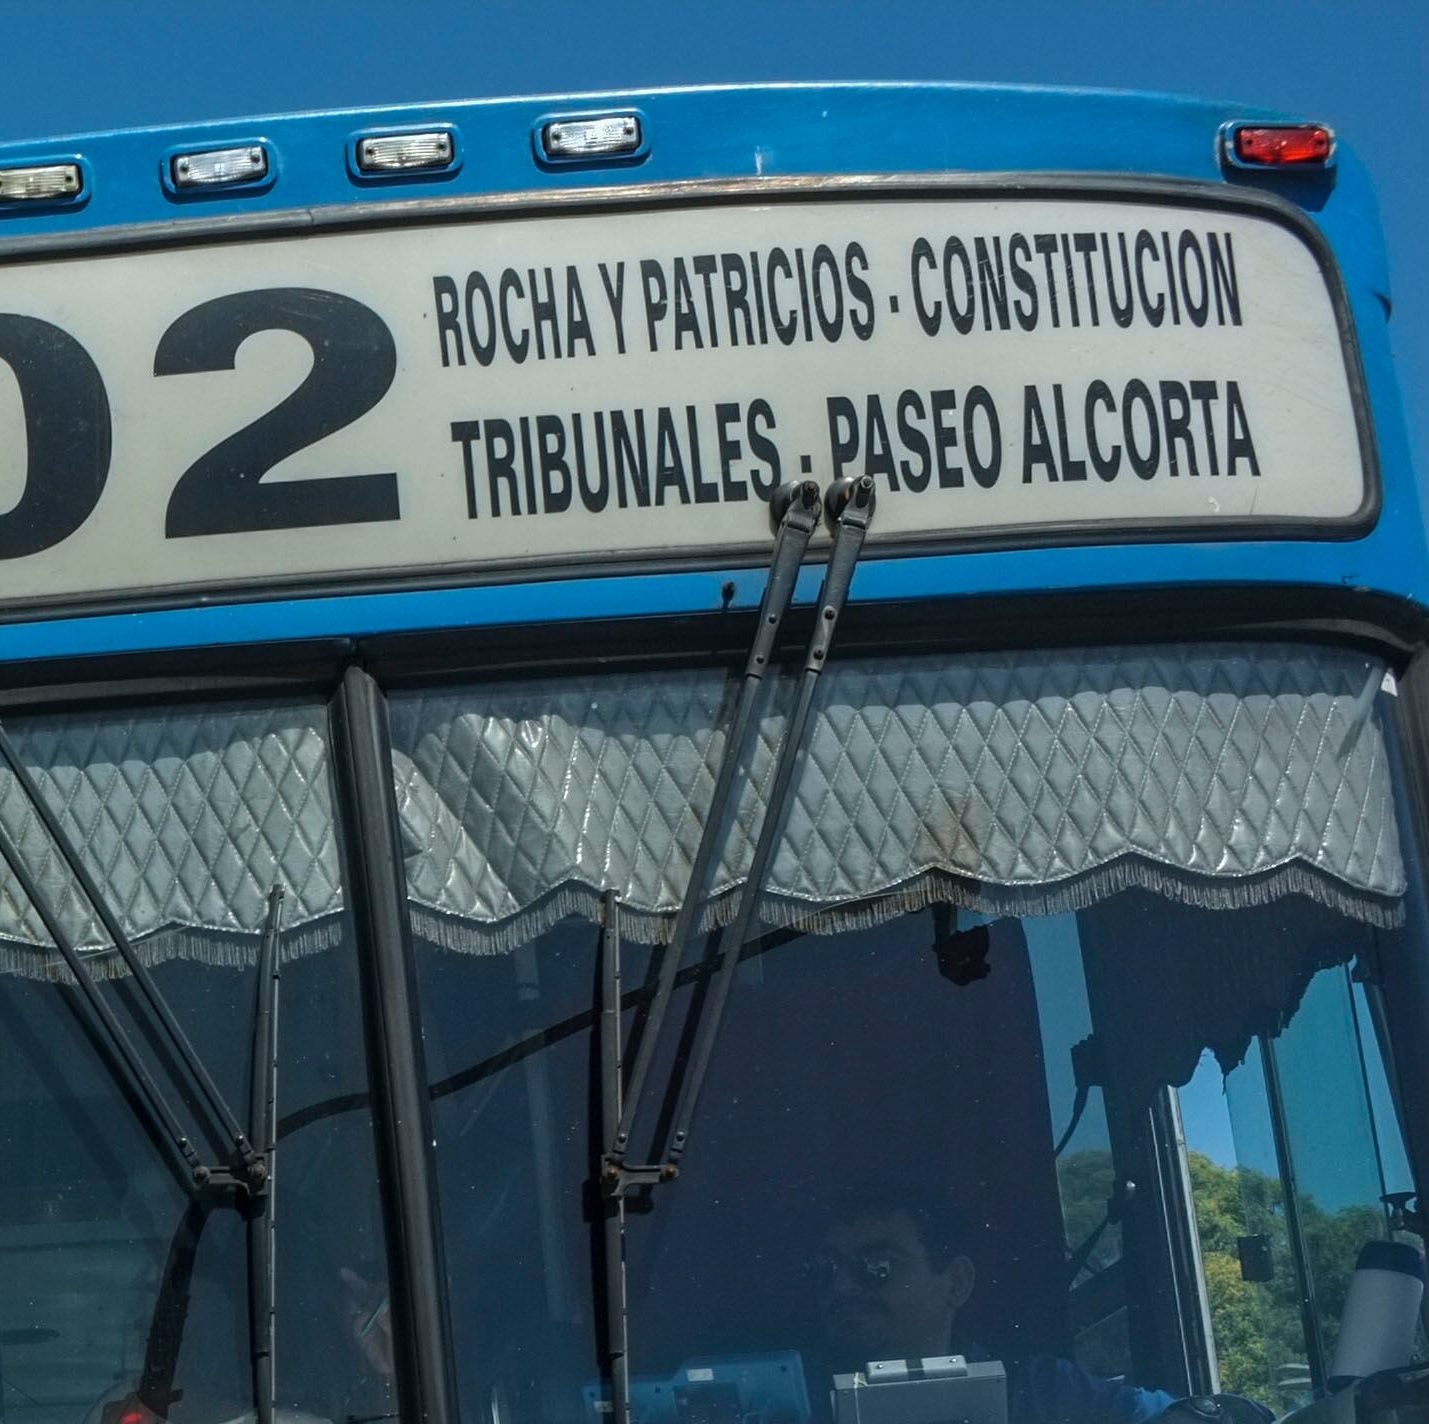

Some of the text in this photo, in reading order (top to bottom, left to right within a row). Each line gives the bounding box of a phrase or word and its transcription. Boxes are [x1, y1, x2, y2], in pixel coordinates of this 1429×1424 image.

[432, 265, 597, 368] ROCHA
[597, 261, 626, 355] Y
[639, 240, 875, 353] PATRICIOS
[910, 229, 1243, 337] CONSTITUCION
[450, 398, 782, 520] TRIBUNALES
[826, 385, 1003, 494] PASEO
[1021, 378, 1262, 484] ALCORTA
